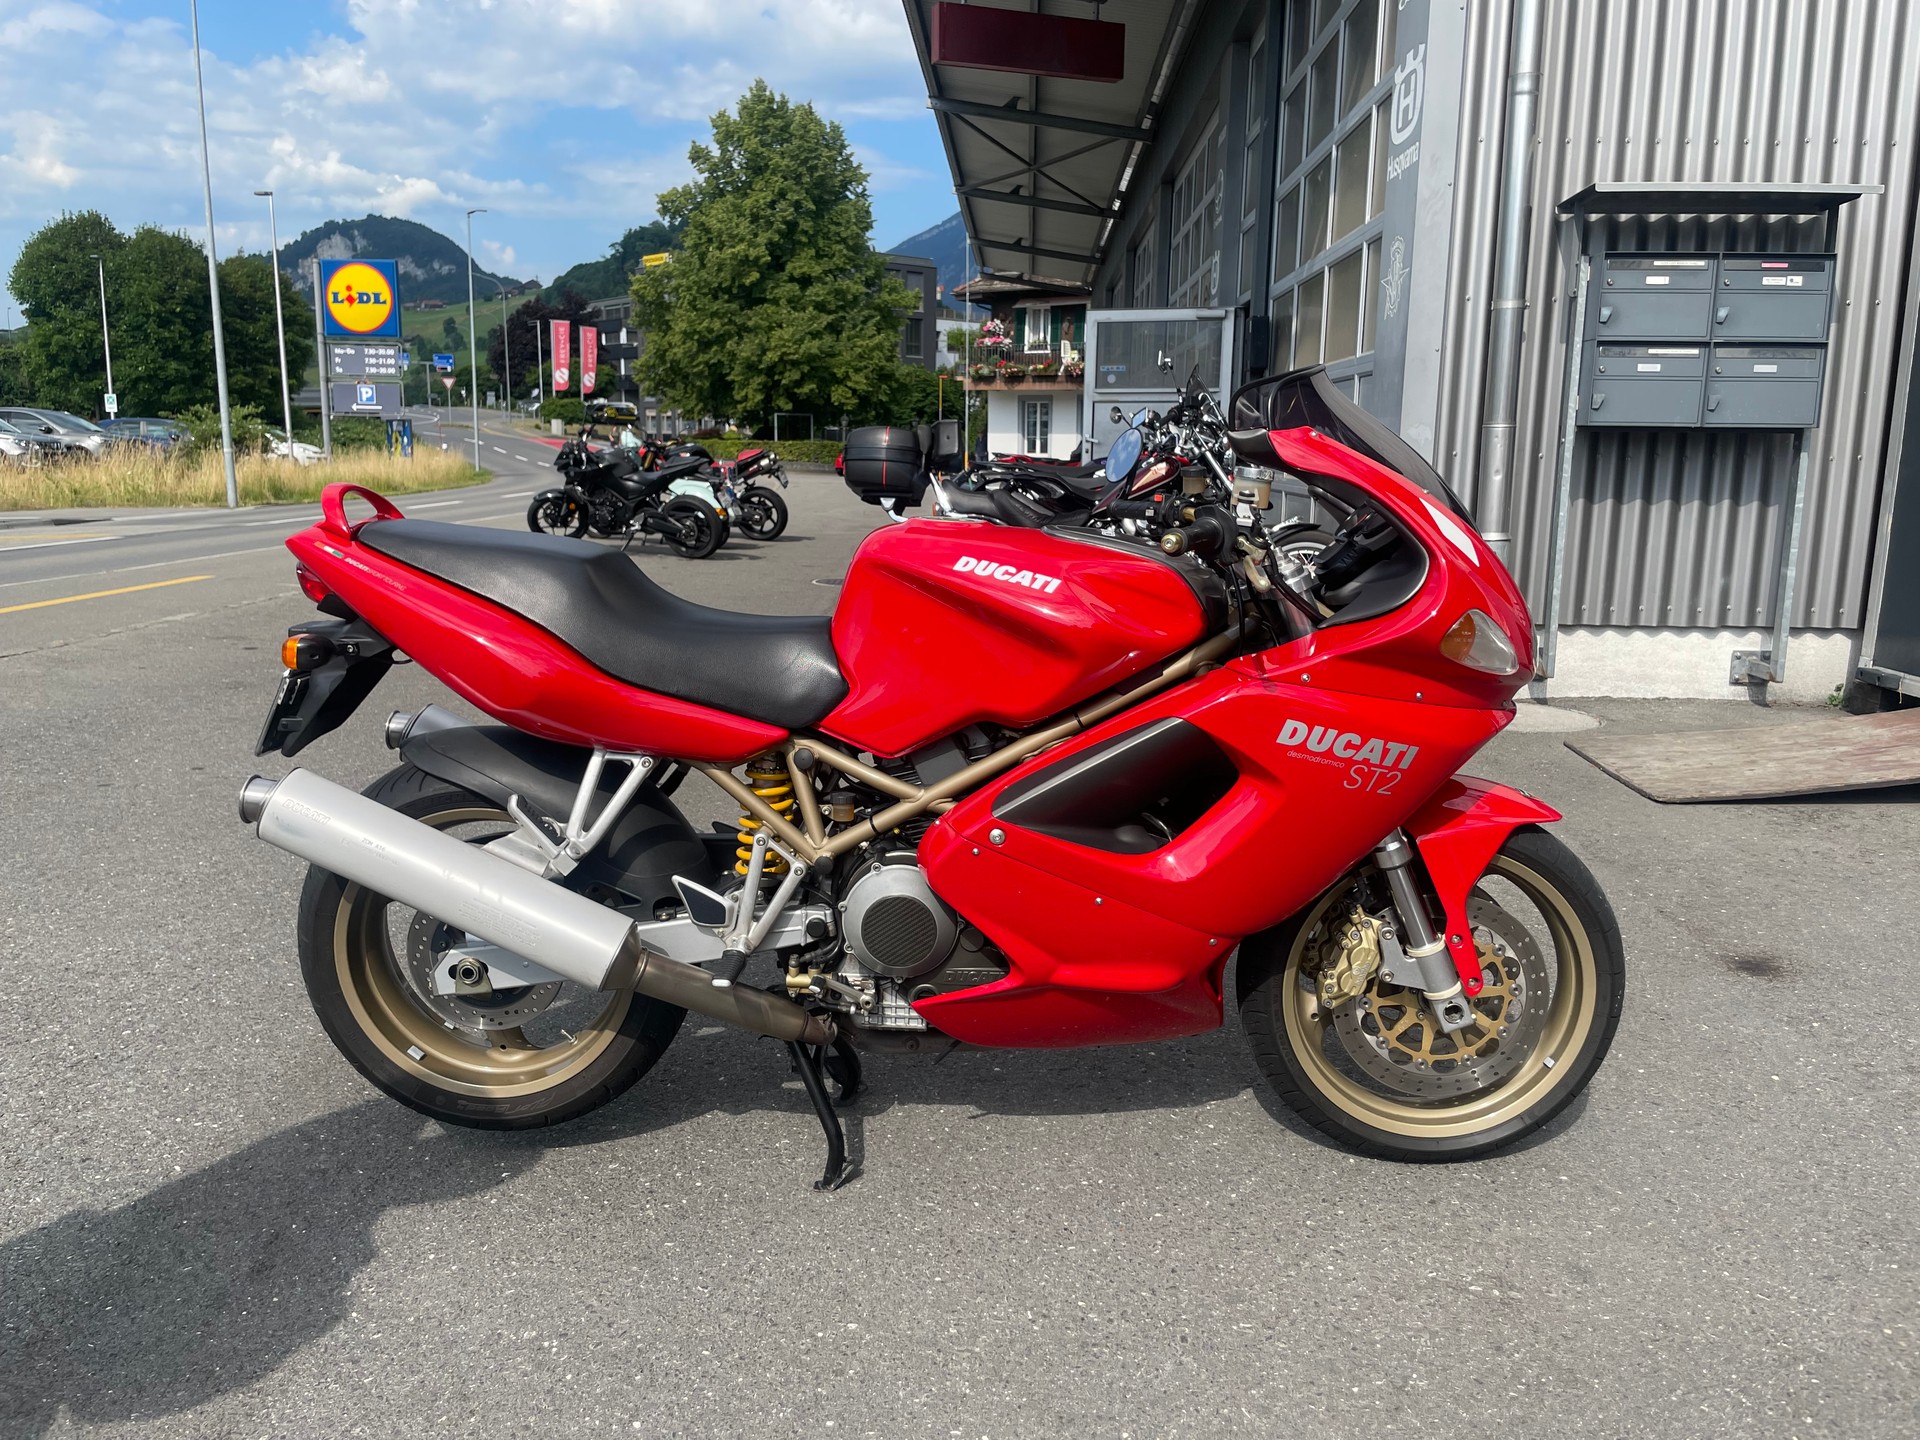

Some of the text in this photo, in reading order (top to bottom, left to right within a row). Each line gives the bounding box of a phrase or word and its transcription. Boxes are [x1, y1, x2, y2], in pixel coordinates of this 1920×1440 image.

[1386, 142, 1419, 182] Husqvarna
[361, 388, 373, 402] P
[952, 555, 1062, 594] DUCATI
[1275, 718, 1420, 770] DUCATI
[1286, 749, 1345, 769] desmodromico
[1343, 764, 1402, 795] ST2
[281, 798, 331, 825] DUCATI
[943, 970, 1006, 984] DUCATI
